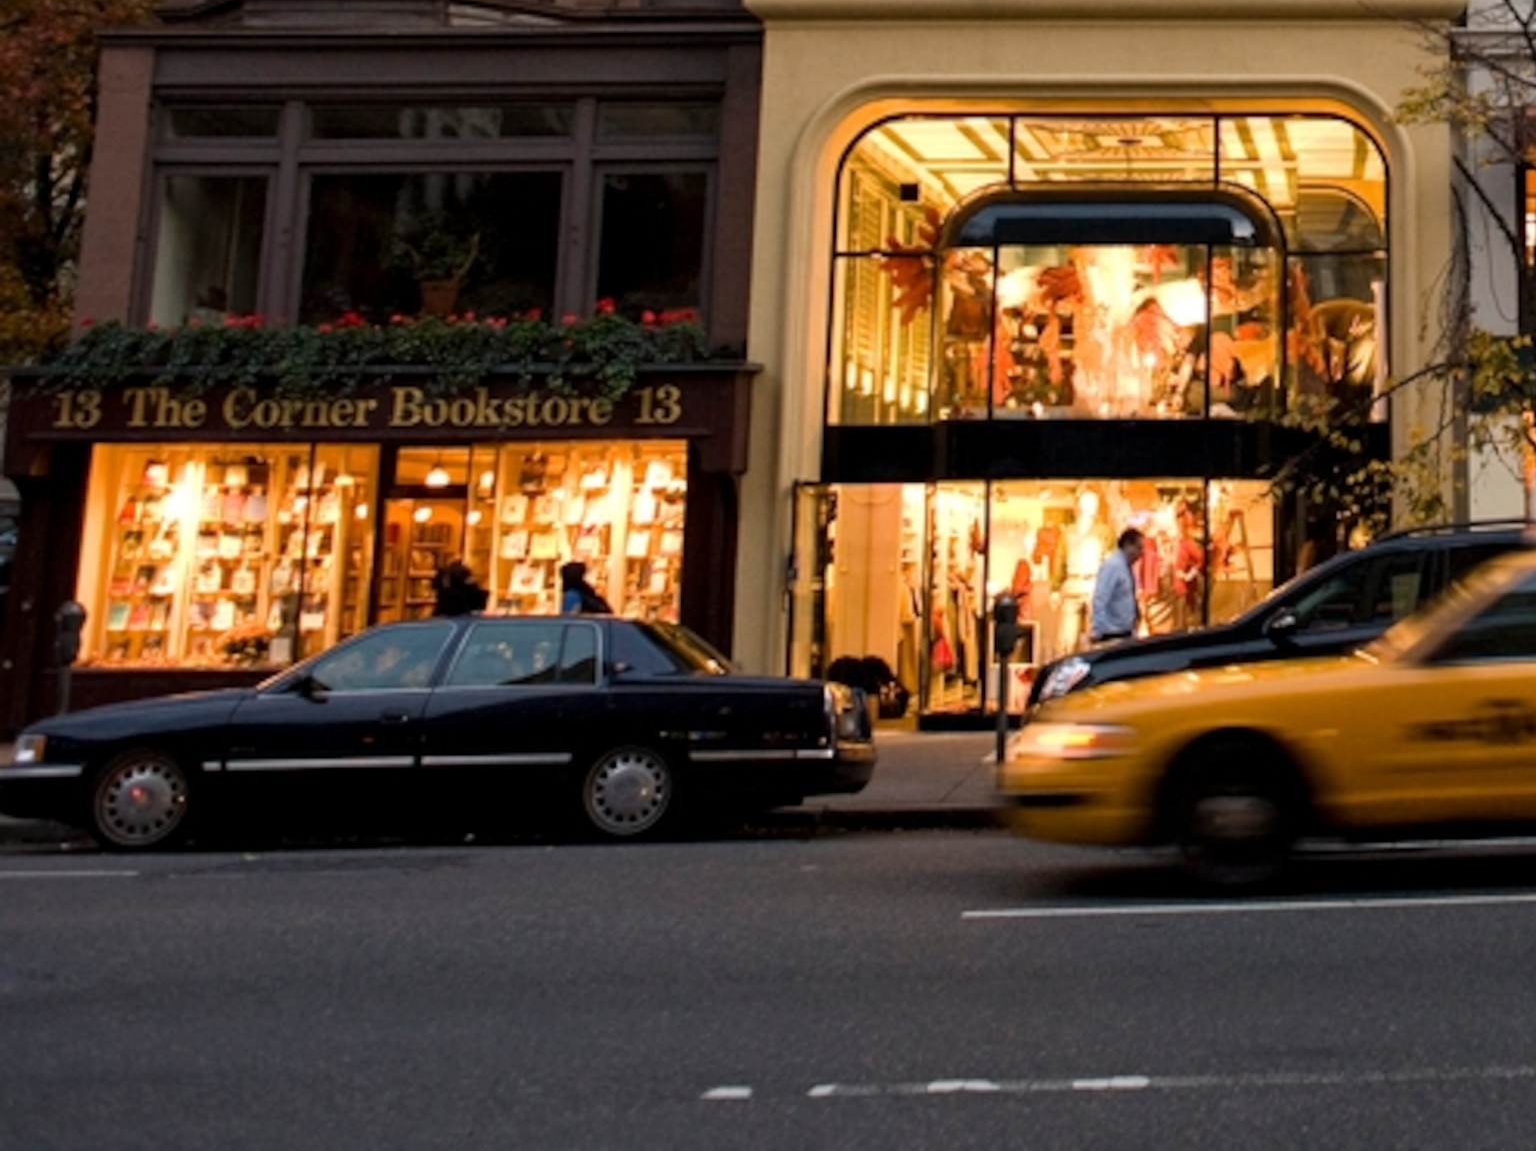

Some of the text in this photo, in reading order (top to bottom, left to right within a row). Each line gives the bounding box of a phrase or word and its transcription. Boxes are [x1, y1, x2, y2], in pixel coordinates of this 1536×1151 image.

[52, 384, 682, 429] 13 The Corner Bookstore 13
